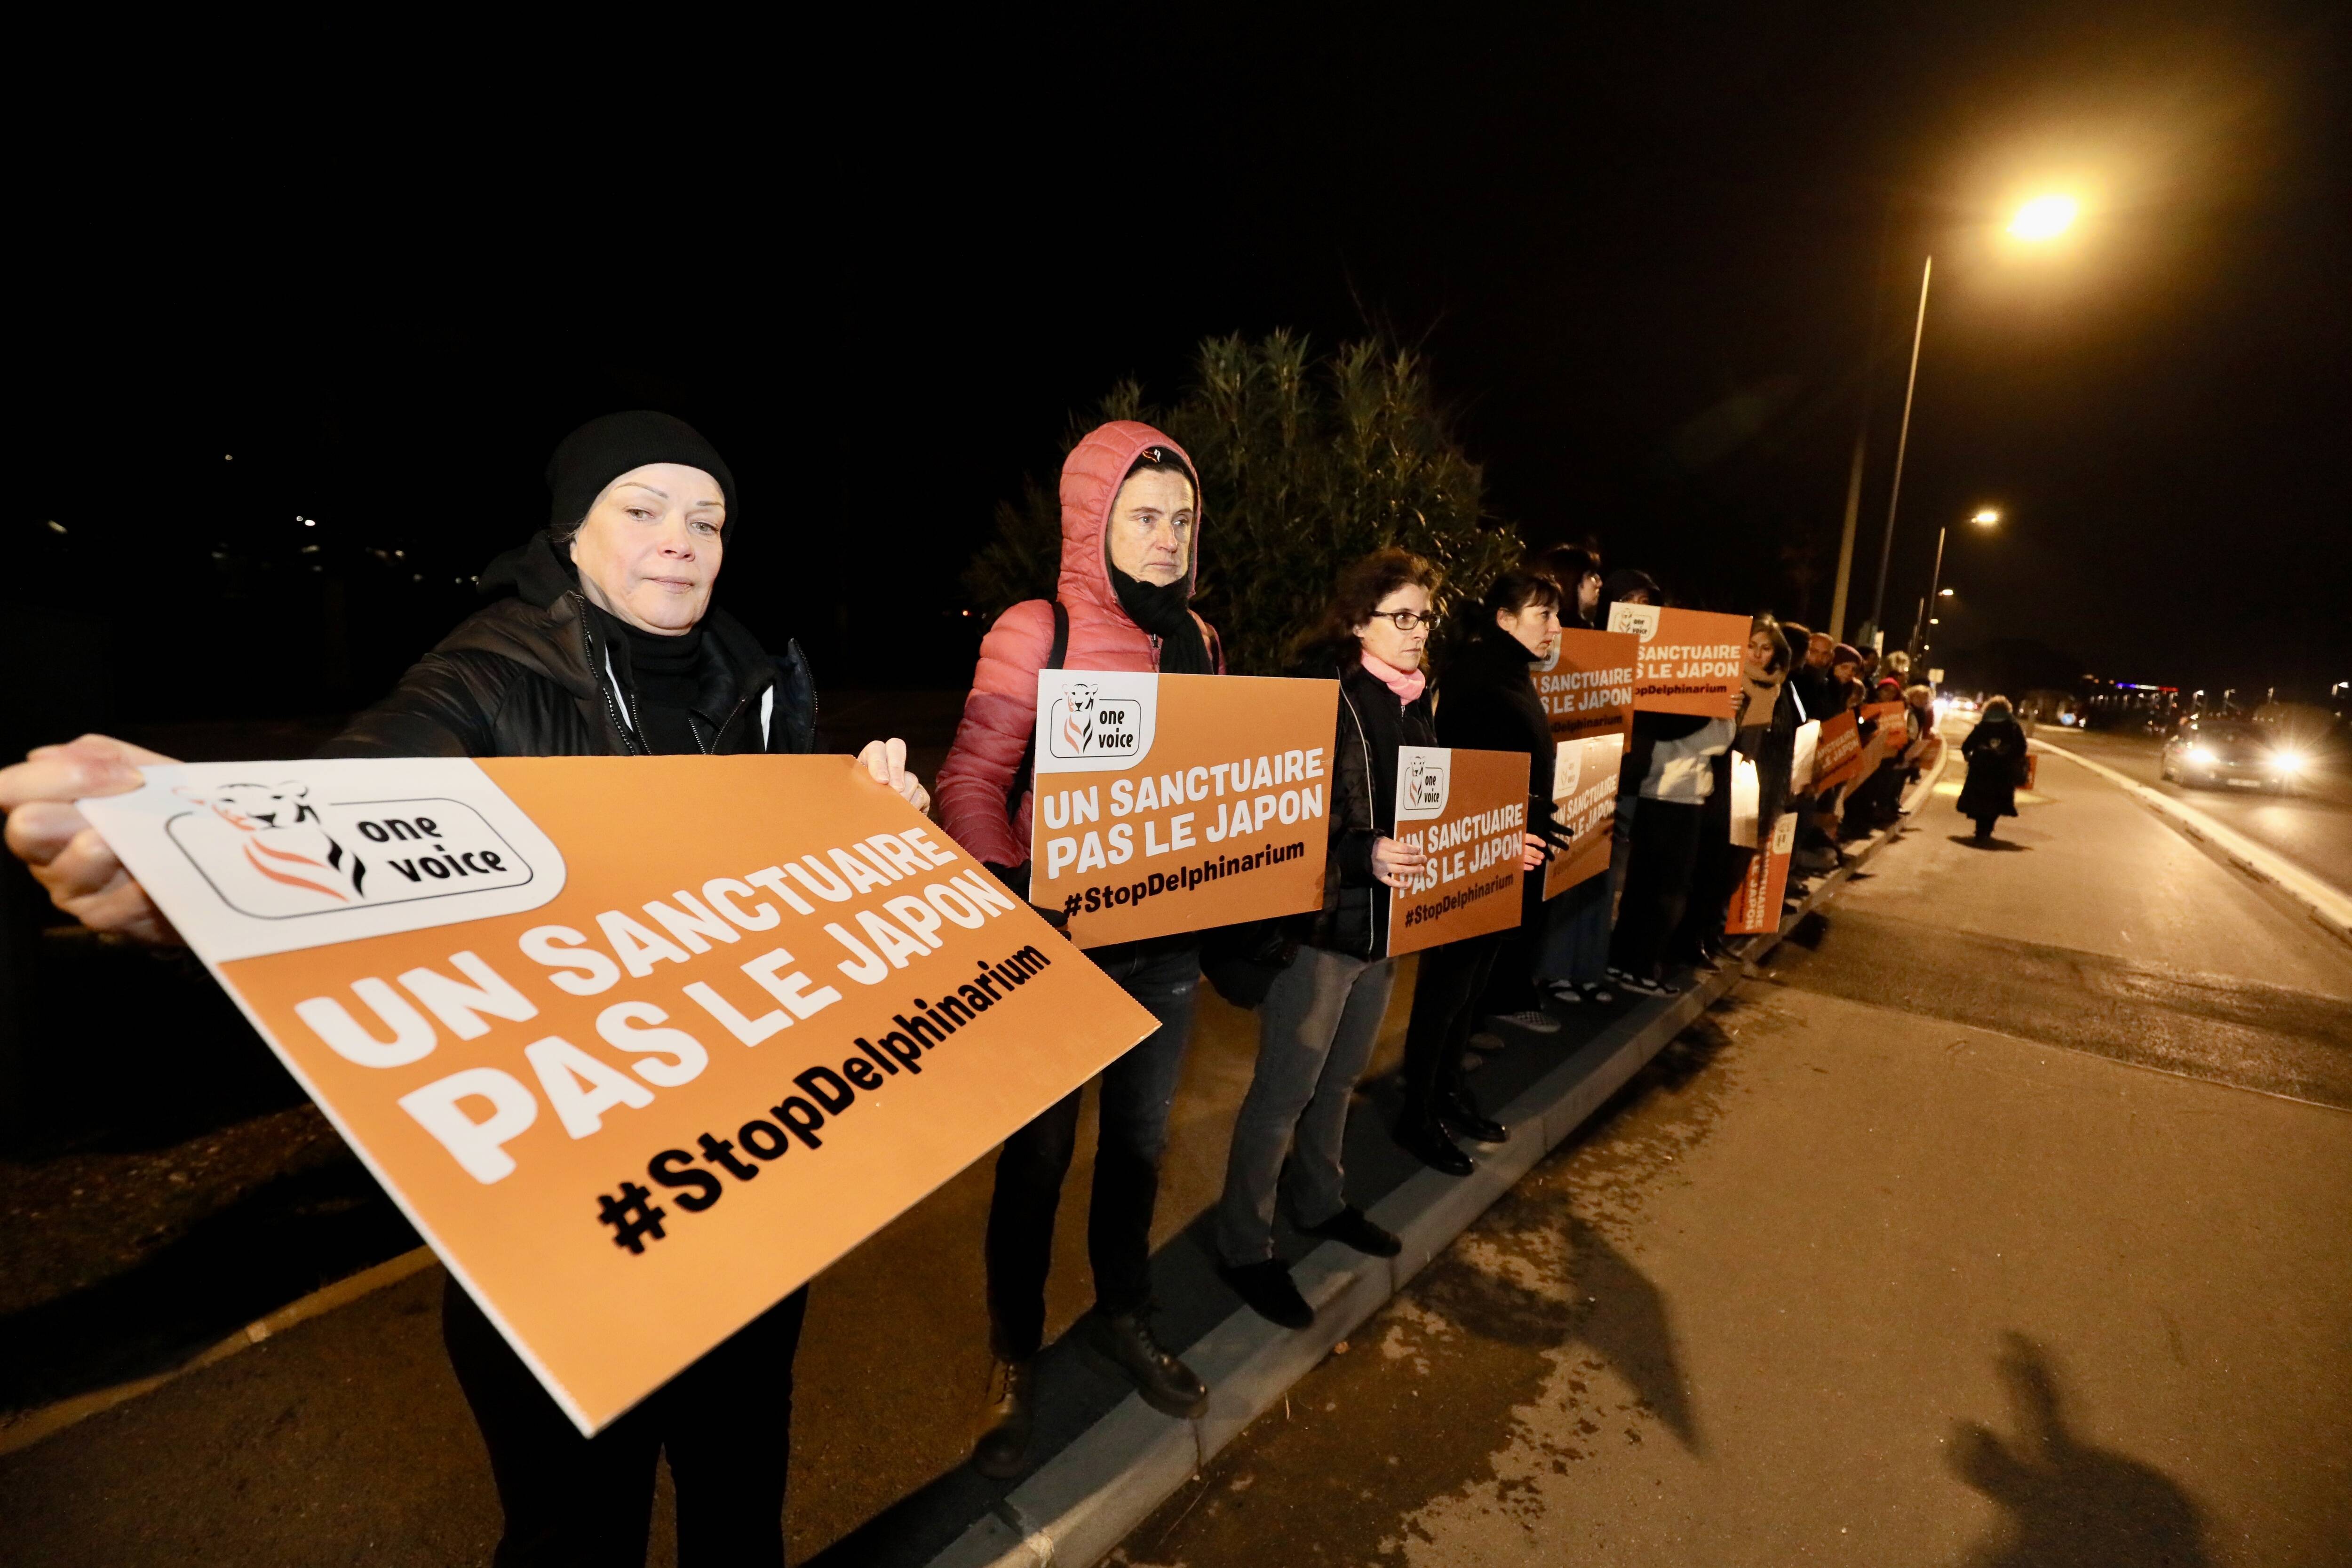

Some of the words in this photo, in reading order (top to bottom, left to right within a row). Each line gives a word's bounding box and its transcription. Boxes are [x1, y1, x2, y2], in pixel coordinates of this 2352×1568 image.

[1541, 667, 1633, 694] SANCTUAIRE
[1648, 663, 1672, 678] LE
[1676, 661, 1740, 678] JAPON
[1553, 694, 1575, 714] LE
[1578, 686, 1632, 711] JAPON
[1635, 684, 1727, 697] opDelphinarium
[1099, 708, 1125, 724] one
[1551, 715, 1623, 733] Delphinarium
[1098, 728, 1134, 748] voice
[1043, 785, 1100, 829] UN
[1110, 747, 1324, 817] SANCTUAIRE
[1424, 788, 1440, 803] voice
[1425, 774, 1437, 786] one
[1567, 773, 1618, 821] SANCTUAIRE
[357, 812, 443, 844] one
[1047, 822, 1133, 880] PAS
[1144, 812, 1196, 857] LE
[1206, 783, 1323, 843] JAPON
[1428, 803, 1523, 854] SANCTUAIRE
[388, 844, 508, 883] voice
[1442, 850, 1465, 884] LE
[1469, 830, 1523, 874] JAPON
[1063, 841, 1304, 917] #StopDelphinarium
[1405, 873, 1514, 928] #StopDelphinarium
[294, 950, 540, 1069] UN
[518, 827, 958, 996] SANCTUAIRE
[397, 1001, 709, 1185] PAS
[682, 947, 842, 1048] LE
[823, 868, 1016, 987] JAPON
[596, 944, 1051, 1256] #StopDelphinarium
